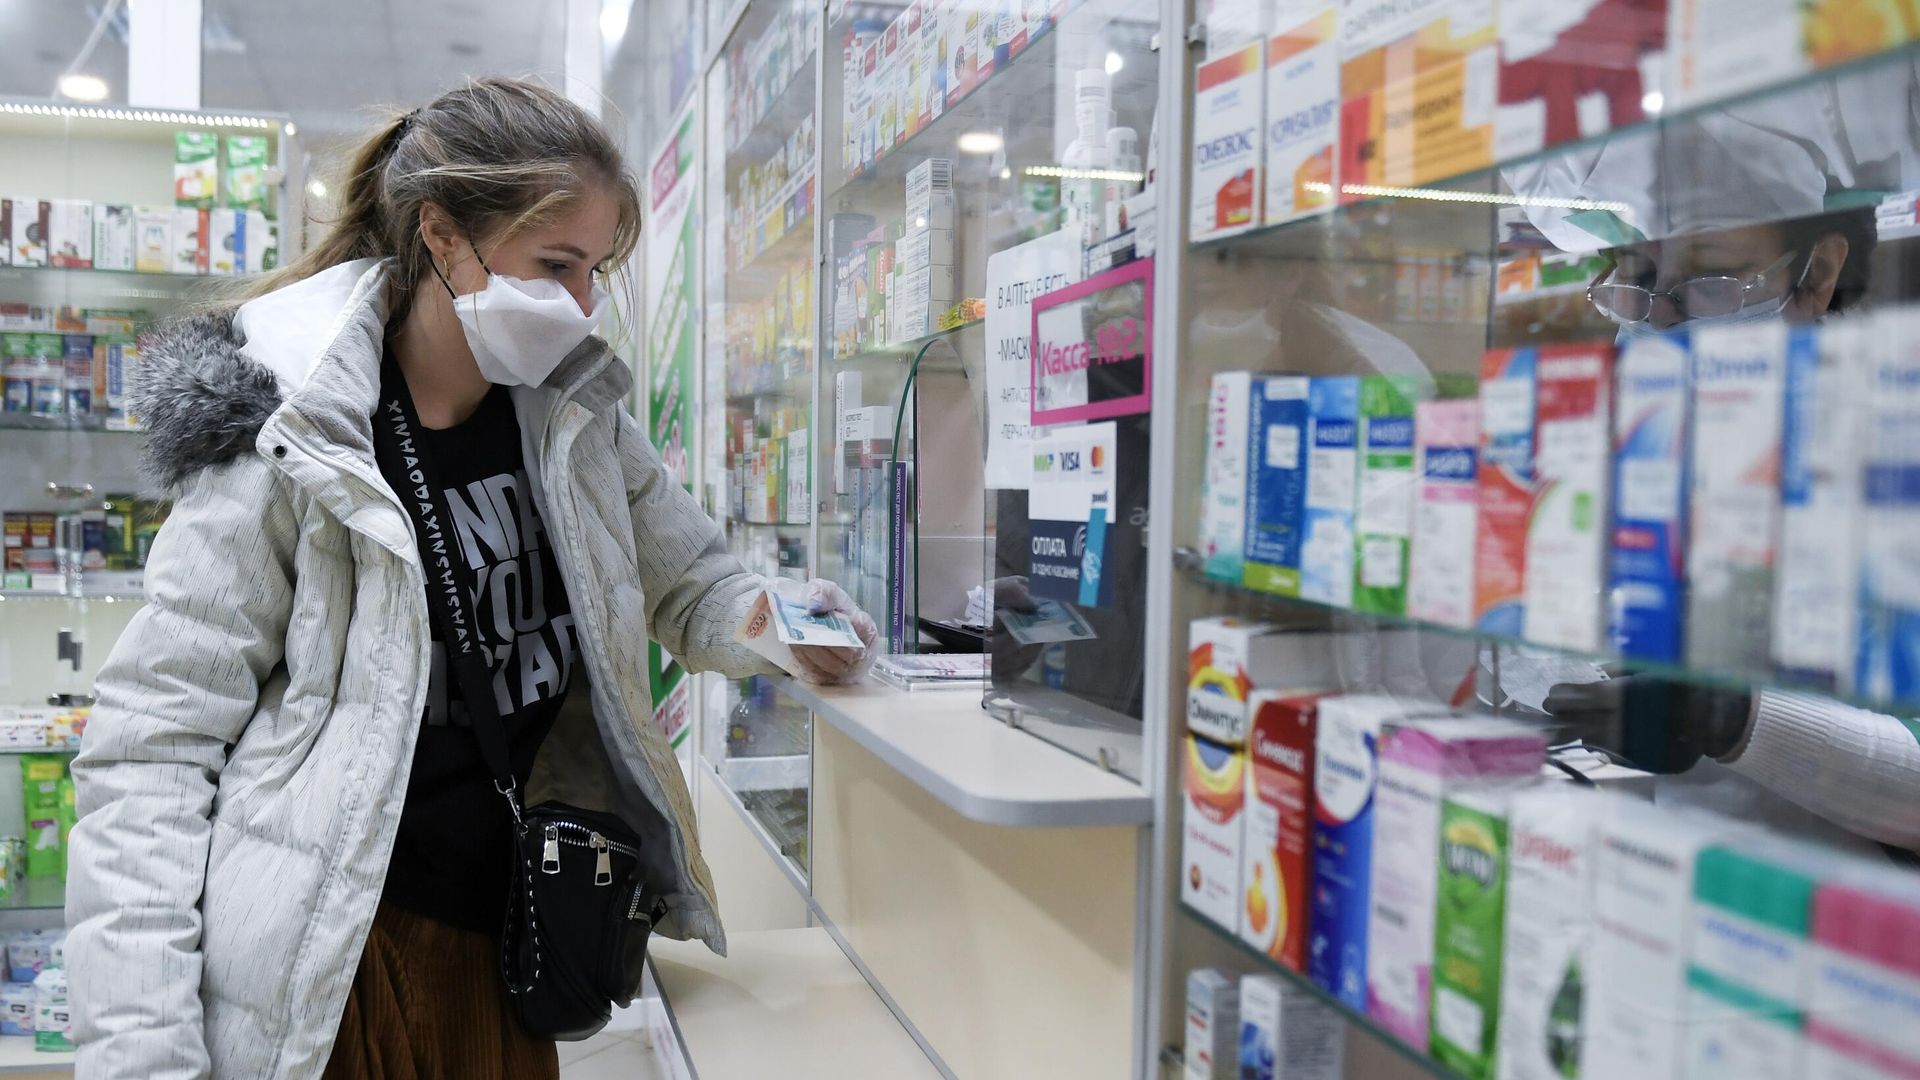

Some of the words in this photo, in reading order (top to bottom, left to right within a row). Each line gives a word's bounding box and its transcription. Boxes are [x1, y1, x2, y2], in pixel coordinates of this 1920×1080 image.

[998, 287, 1004, 309] В
[1041, 340, 1090, 377] Касса
[1059, 451, 1081, 471] VISA
[1032, 537, 1067, 558] ОПЛАТА
[747, 612, 767, 640] 5000
